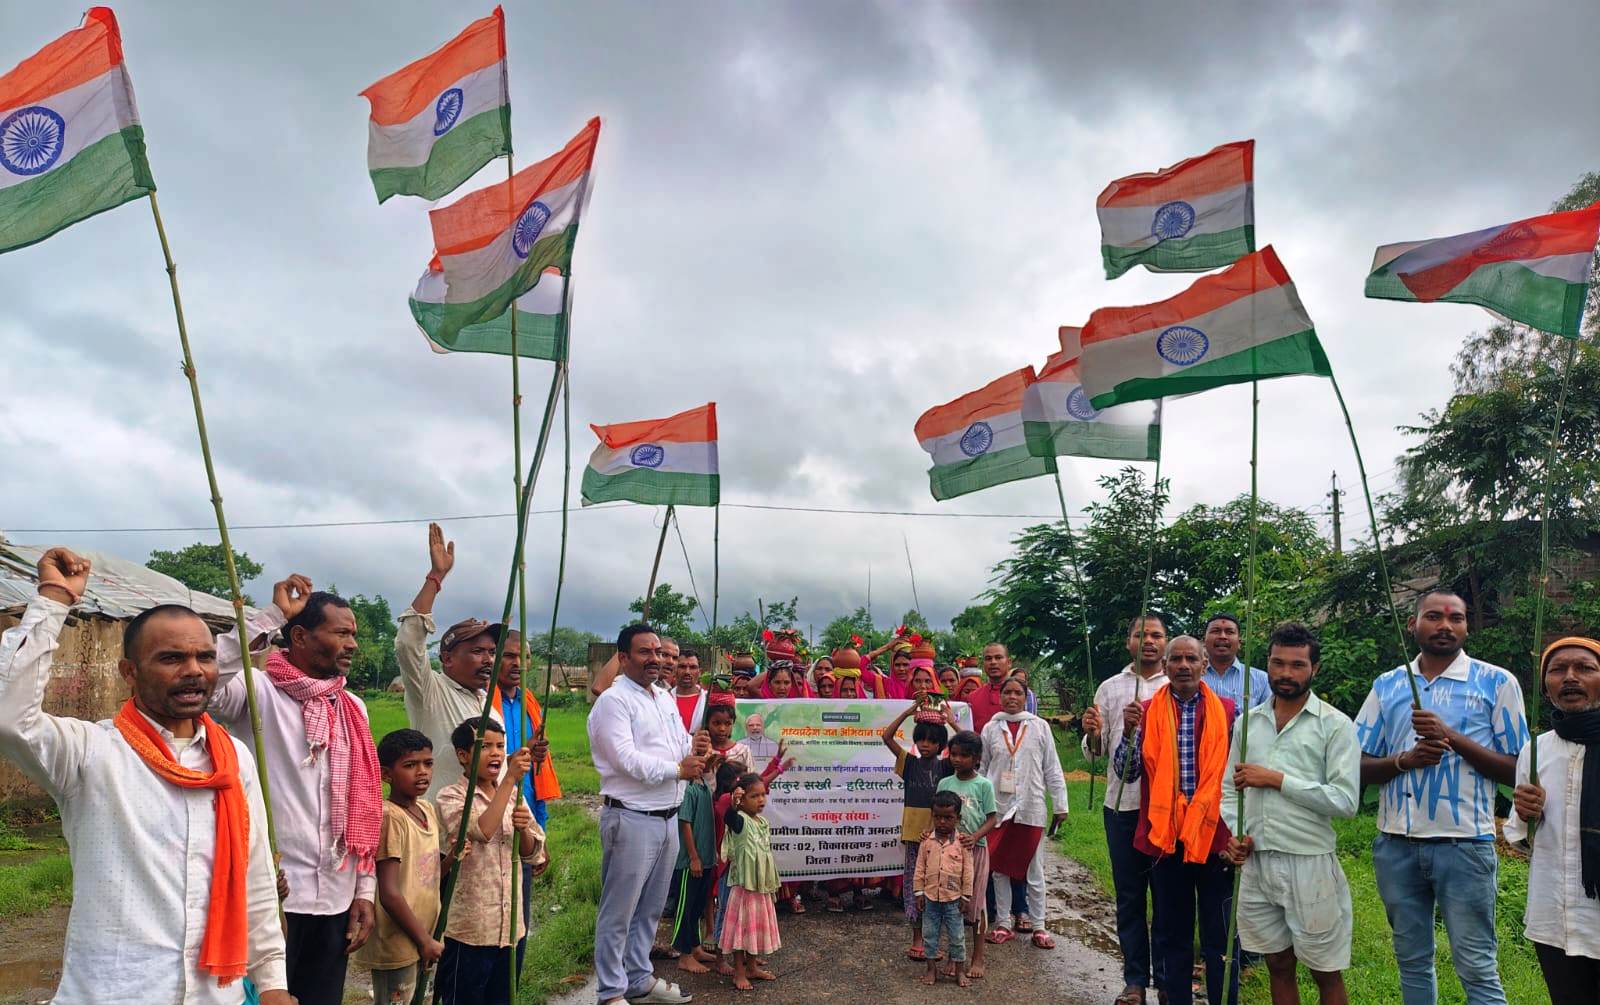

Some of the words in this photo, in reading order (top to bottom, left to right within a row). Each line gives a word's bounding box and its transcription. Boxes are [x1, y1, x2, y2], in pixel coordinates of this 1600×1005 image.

[781, 726, 820, 737] मध्यप्रदेश
[822, 727, 837, 737] जन
[840, 726, 873, 737] अभियान
[769, 778, 800, 794] वांकुर
[804, 778, 832, 790] सखी
[846, 778, 893, 791] हरियाली
[811, 811, 842, 823] नवांकुर
[845, 811, 869, 821] संस्था
[802, 826, 832, 836] विकास
[835, 825, 864, 835] समिति
[819, 840, 871, 851] विकासखण्ड
[806, 855, 831, 865] जिला
[841, 854, 874, 864] डिण्डोरी
